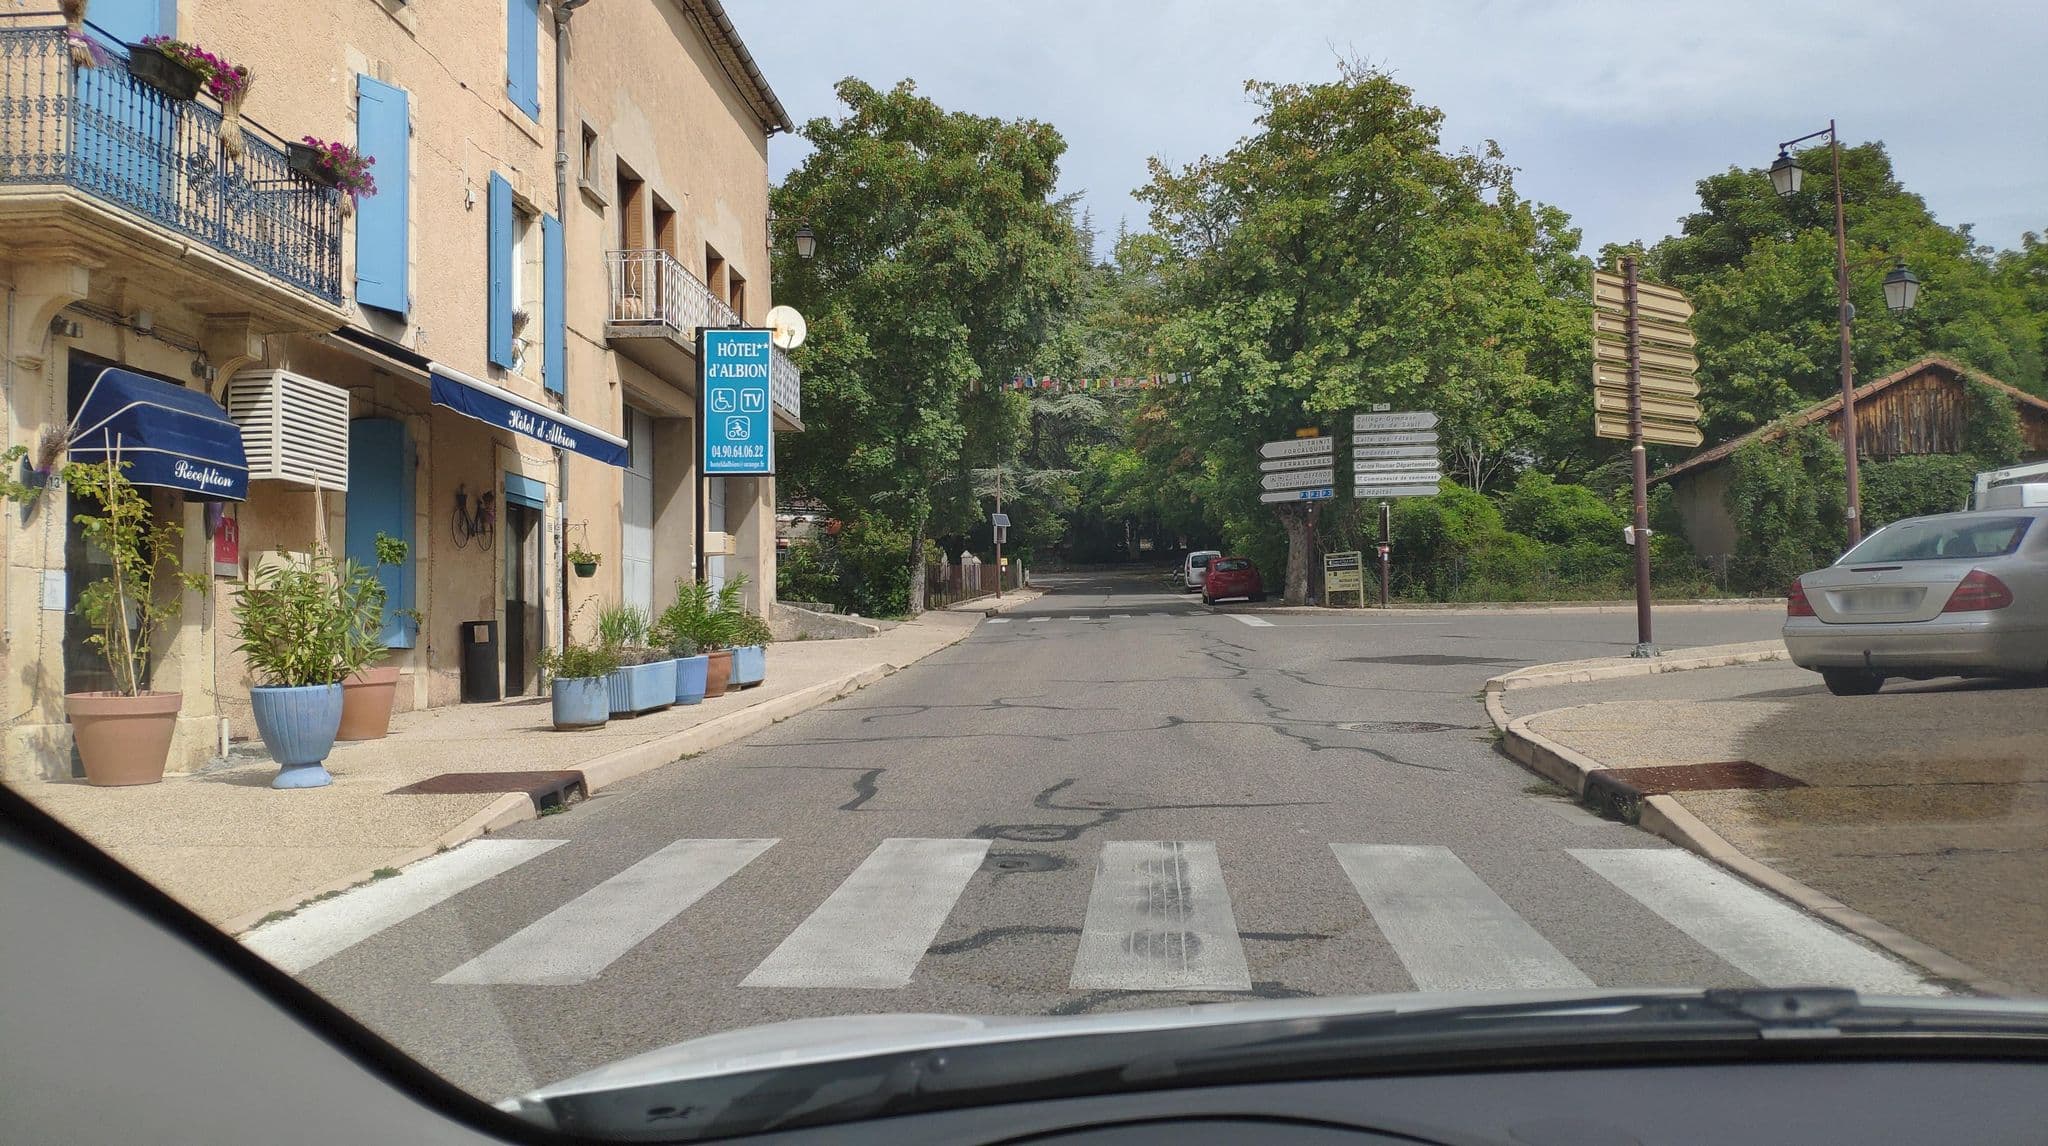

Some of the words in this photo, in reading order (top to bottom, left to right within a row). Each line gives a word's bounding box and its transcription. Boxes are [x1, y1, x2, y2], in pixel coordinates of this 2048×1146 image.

[717, 338, 760, 357] HÔTEL
[709, 363, 767, 378] d'ALBION
[743, 393, 761, 407] TV
[508, 410, 535, 435] Hôtel
[537, 420, 578, 449] d'Albion
[711, 445, 764, 458] 04.90.64.06.22
[1283, 446, 1330, 454] FORCALQUIER
[1355, 448, 1400, 456] Gendarmerie
[174, 459, 234, 490] Réception
